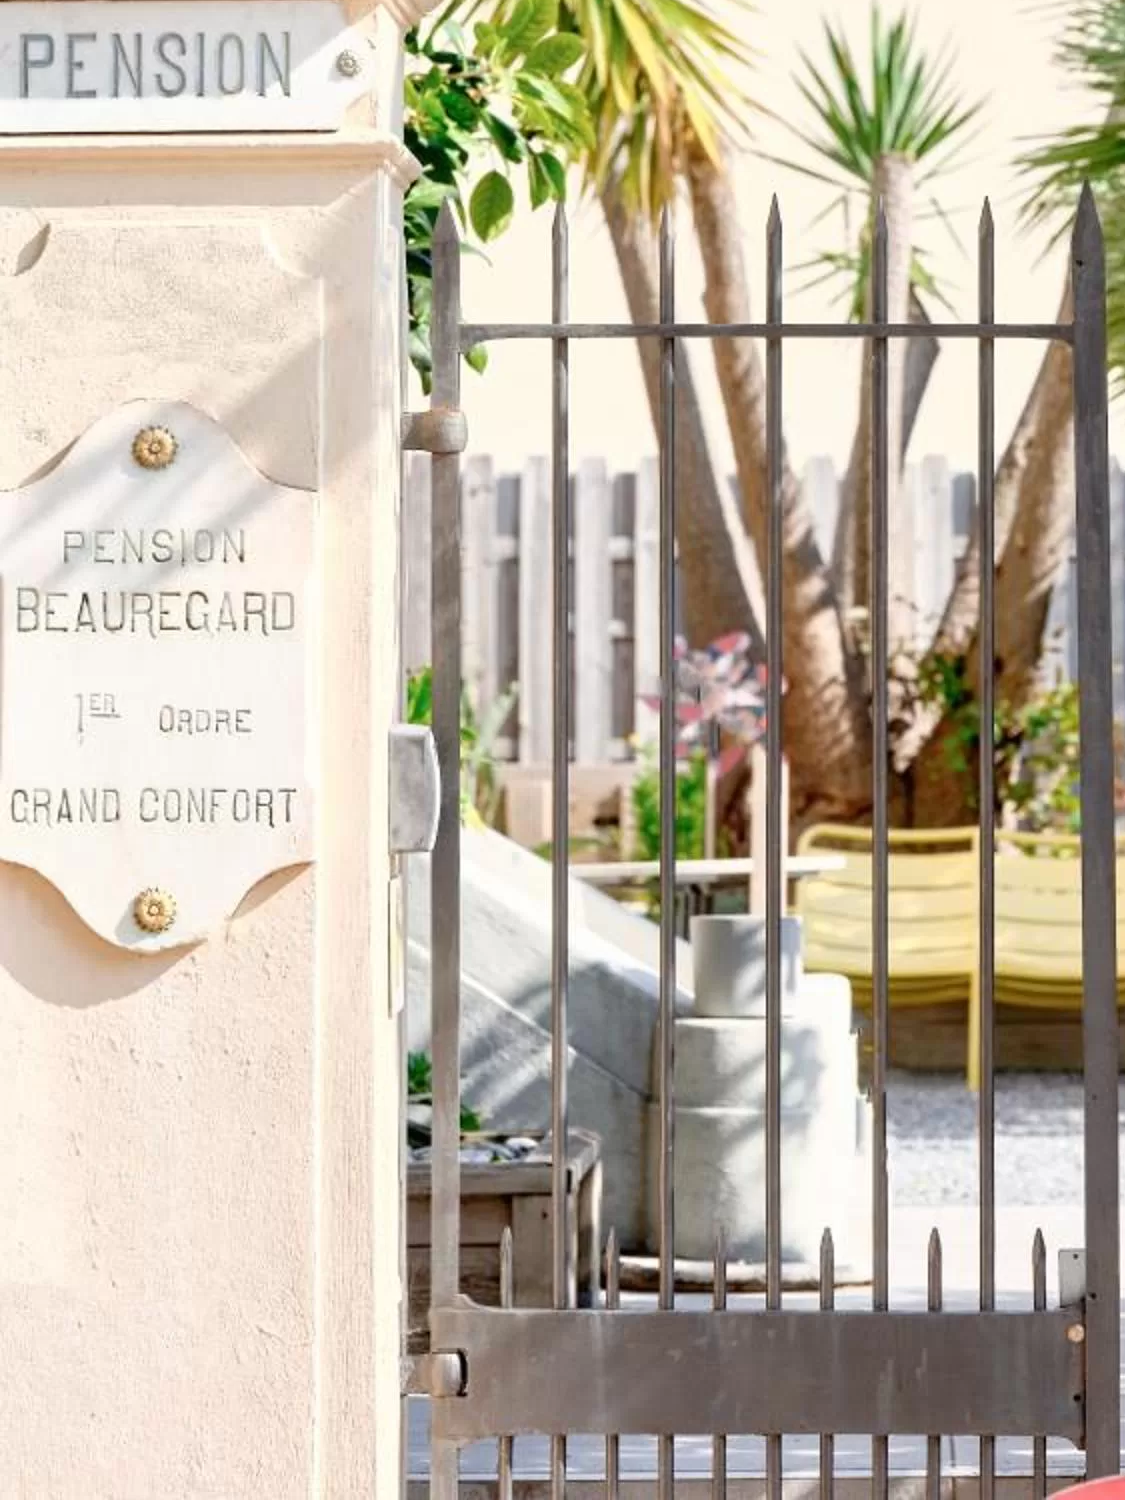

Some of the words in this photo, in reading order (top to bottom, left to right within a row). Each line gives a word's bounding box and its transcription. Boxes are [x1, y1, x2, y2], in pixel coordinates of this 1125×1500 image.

[18, 30, 292, 99] PENSION
[62, 528, 246, 566] PENSION
[16, 586, 297, 637] BEAUREGARD
[10, 787, 121, 827] GRAND
[139, 787, 297, 828] CONFORT
